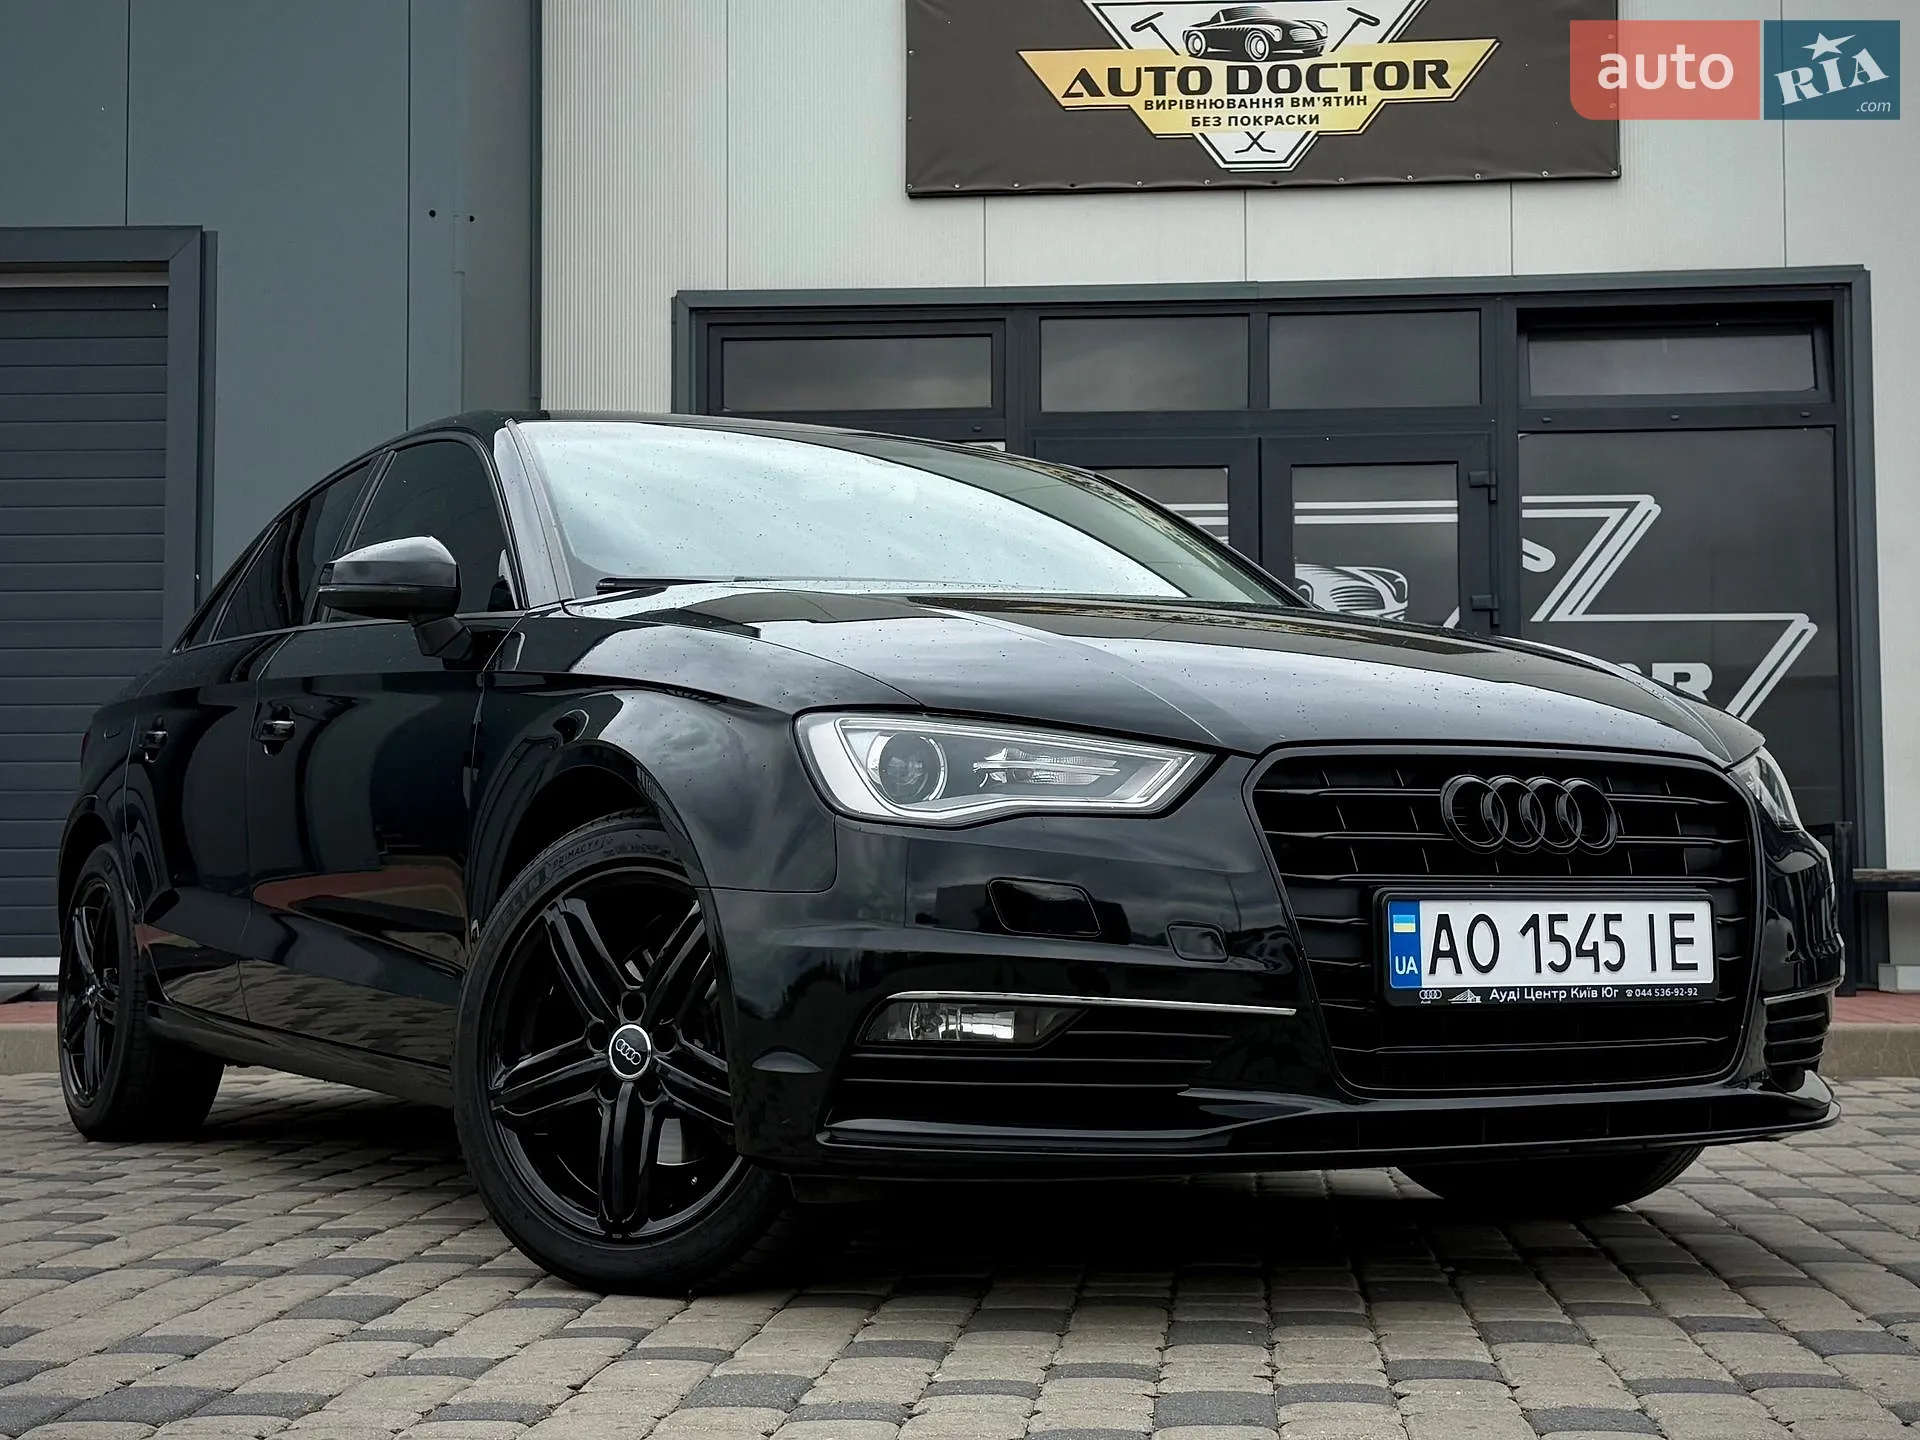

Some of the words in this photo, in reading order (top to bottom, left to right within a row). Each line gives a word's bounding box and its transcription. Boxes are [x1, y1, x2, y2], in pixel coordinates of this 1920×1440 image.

[1062, 65, 1212, 98] AUTO
[1226, 59, 1452, 95] DOCTOR
[1144, 97, 1285, 111] ВИРІВНЮВАННЯ
[1290, 95, 1368, 108] ВМ'ЯТИН
[1191, 116, 1222, 127] БЕЗ
[1228, 113, 1320, 127] ПОКРАСКИ
[1428, 913, 1501, 975] AO
[1519, 913, 1626, 974] 1545
[1648, 913, 1699, 973] IE
[1394, 955, 1419, 975] UA
[1489, 987, 1520, 1003] Ауді
[1524, 987, 1567, 1001] Центр
[1570, 987, 1598, 999] Київ
[1601, 986, 1619, 998] Юг
[1634, 988, 1652, 998] 044
[1654, 987, 1699, 998] 536-92-92
